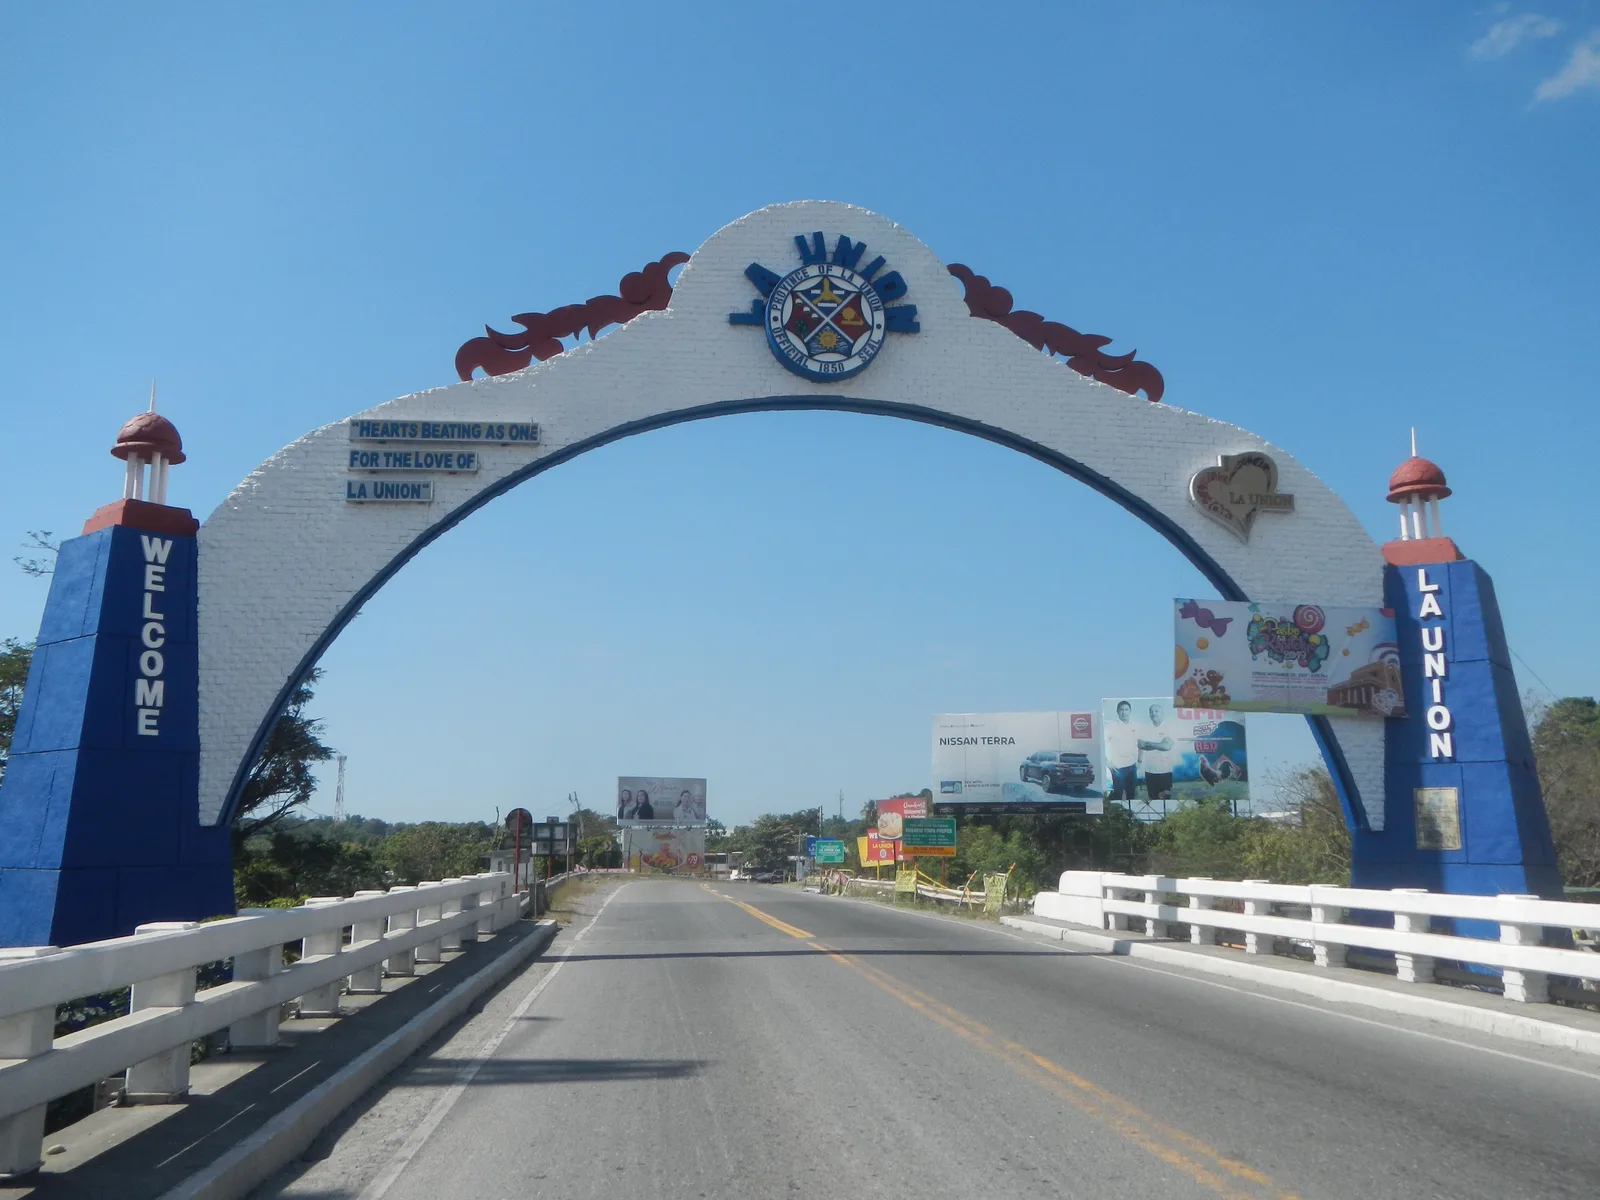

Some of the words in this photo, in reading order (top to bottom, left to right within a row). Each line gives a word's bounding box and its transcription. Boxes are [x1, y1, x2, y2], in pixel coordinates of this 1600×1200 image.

[729, 262, 784, 326] LA
[794, 231, 921, 333] UNION
[771, 268, 810, 311] PROVINCE
[817, 265, 833, 276] OF
[840, 271, 856, 284] LA
[859, 282, 883, 312] UNION
[771, 325, 809, 369] OFFICIAL
[818, 362, 846, 374] 1850
[857, 338, 882, 364] SEAL
[421, 421, 482, 440] BEATING
[485, 423, 505, 440] AS
[508, 423, 539, 441] ONE
[350, 450, 380, 468] FOR
[383, 450, 412, 468] THE
[414, 450, 454, 469] LOVE
[456, 452, 476, 469] OF
[347, 481, 368, 500] LA
[1417, 568, 1443, 618] LA
[134, 534, 173, 737] WELCOME
[1421, 626, 1452, 759] UNION
[939, 736, 978, 747] NISSAN
[980, 736, 1016, 746] TERRA
